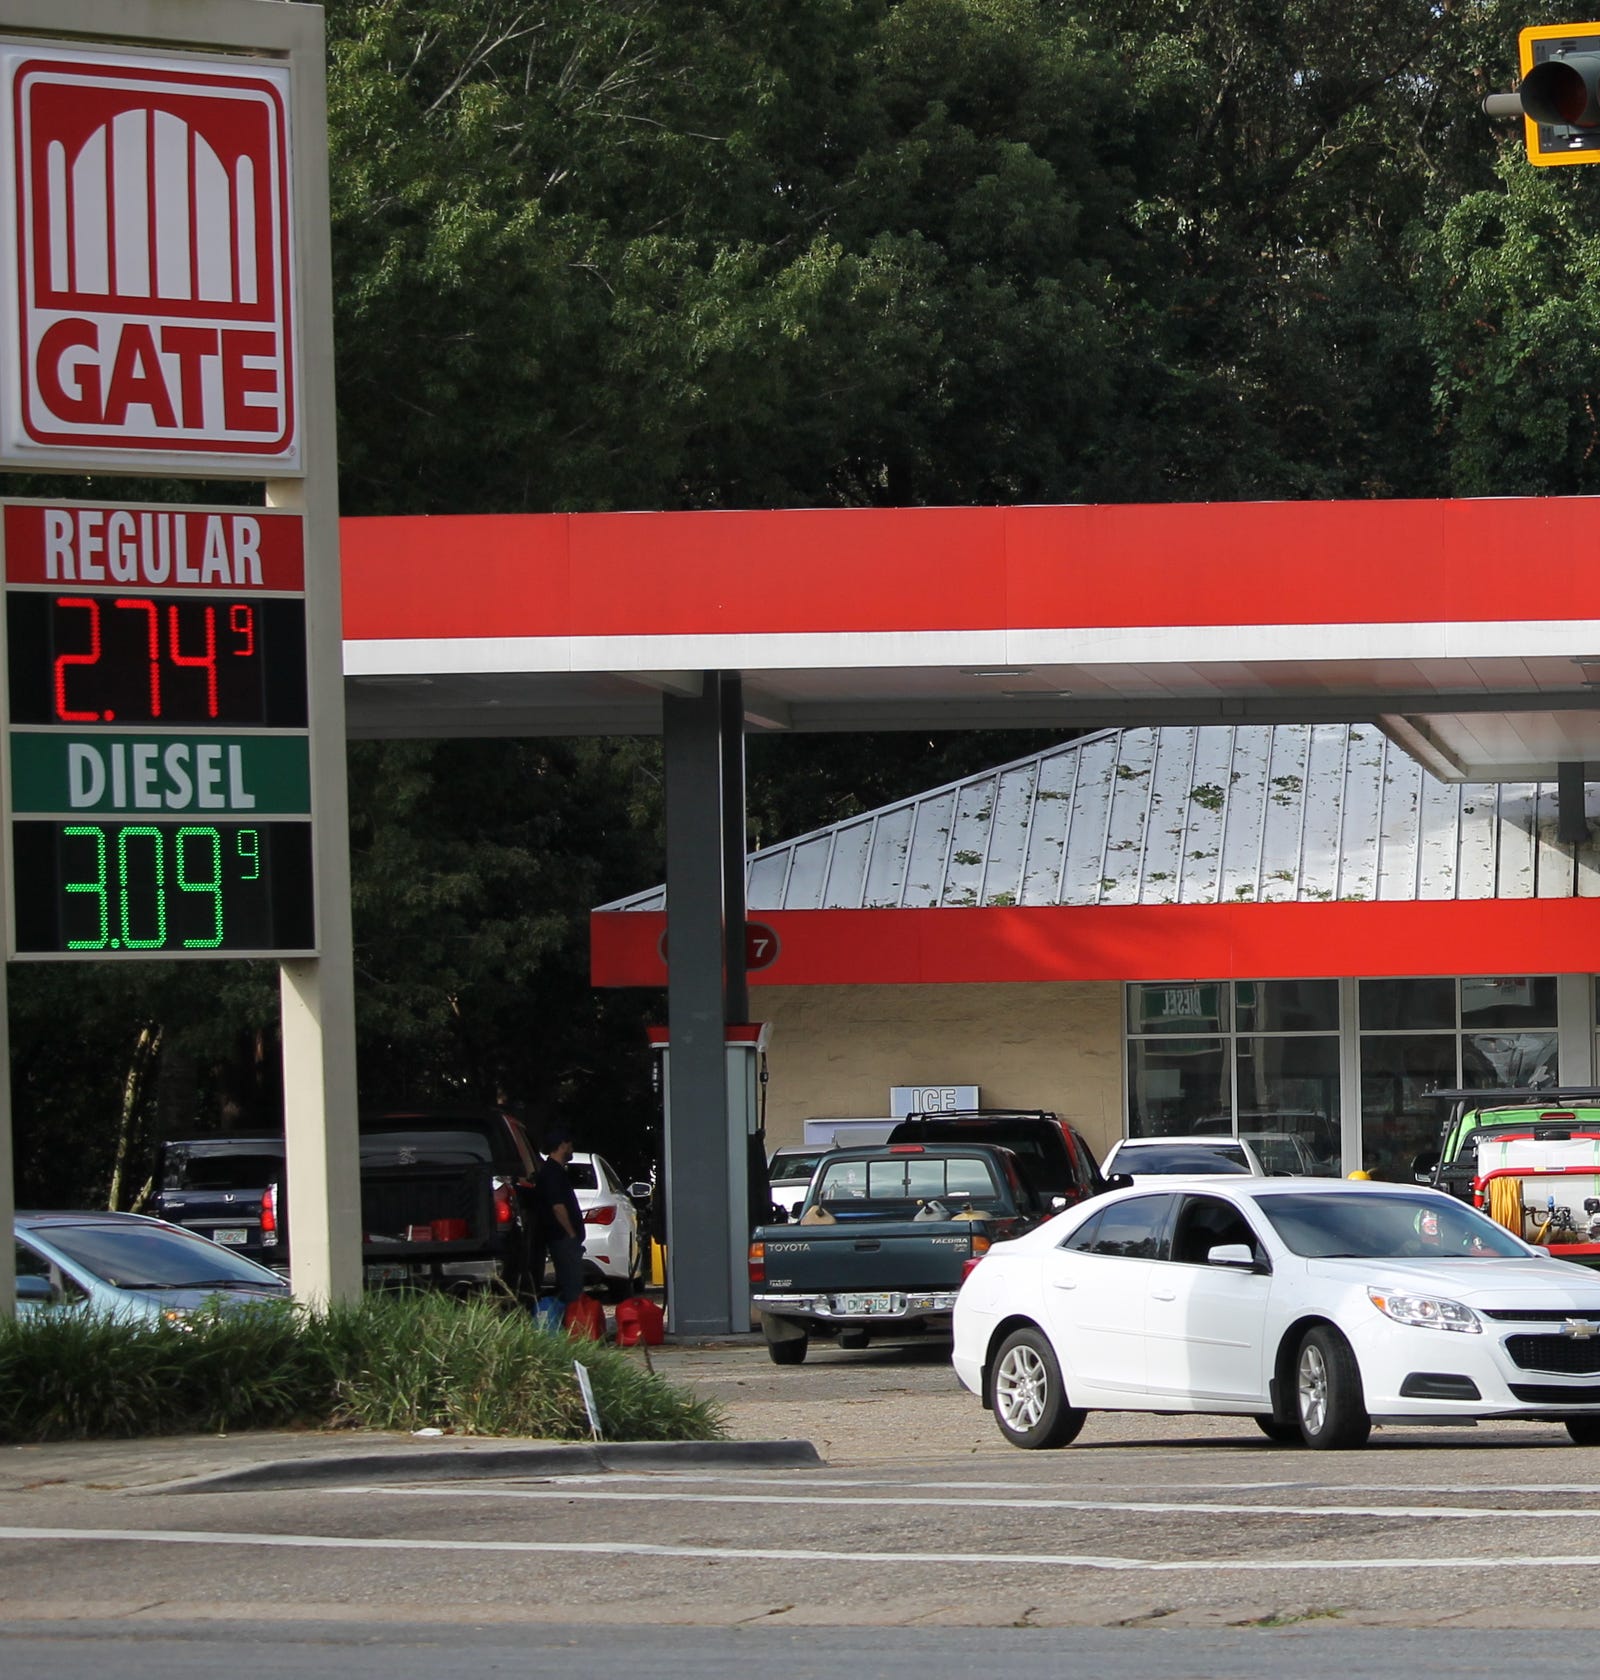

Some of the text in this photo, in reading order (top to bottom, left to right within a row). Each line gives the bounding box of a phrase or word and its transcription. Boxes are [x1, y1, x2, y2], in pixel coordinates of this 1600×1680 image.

[36, 317, 279, 432] GATE
[44, 509, 263, 585] REGULAR
[68, 743, 255, 809] DIESEL
[753, 939, 769, 957] 7
[912, 1088, 956, 1113] ICE
[767, 1243, 810, 1252] TOYOTA
